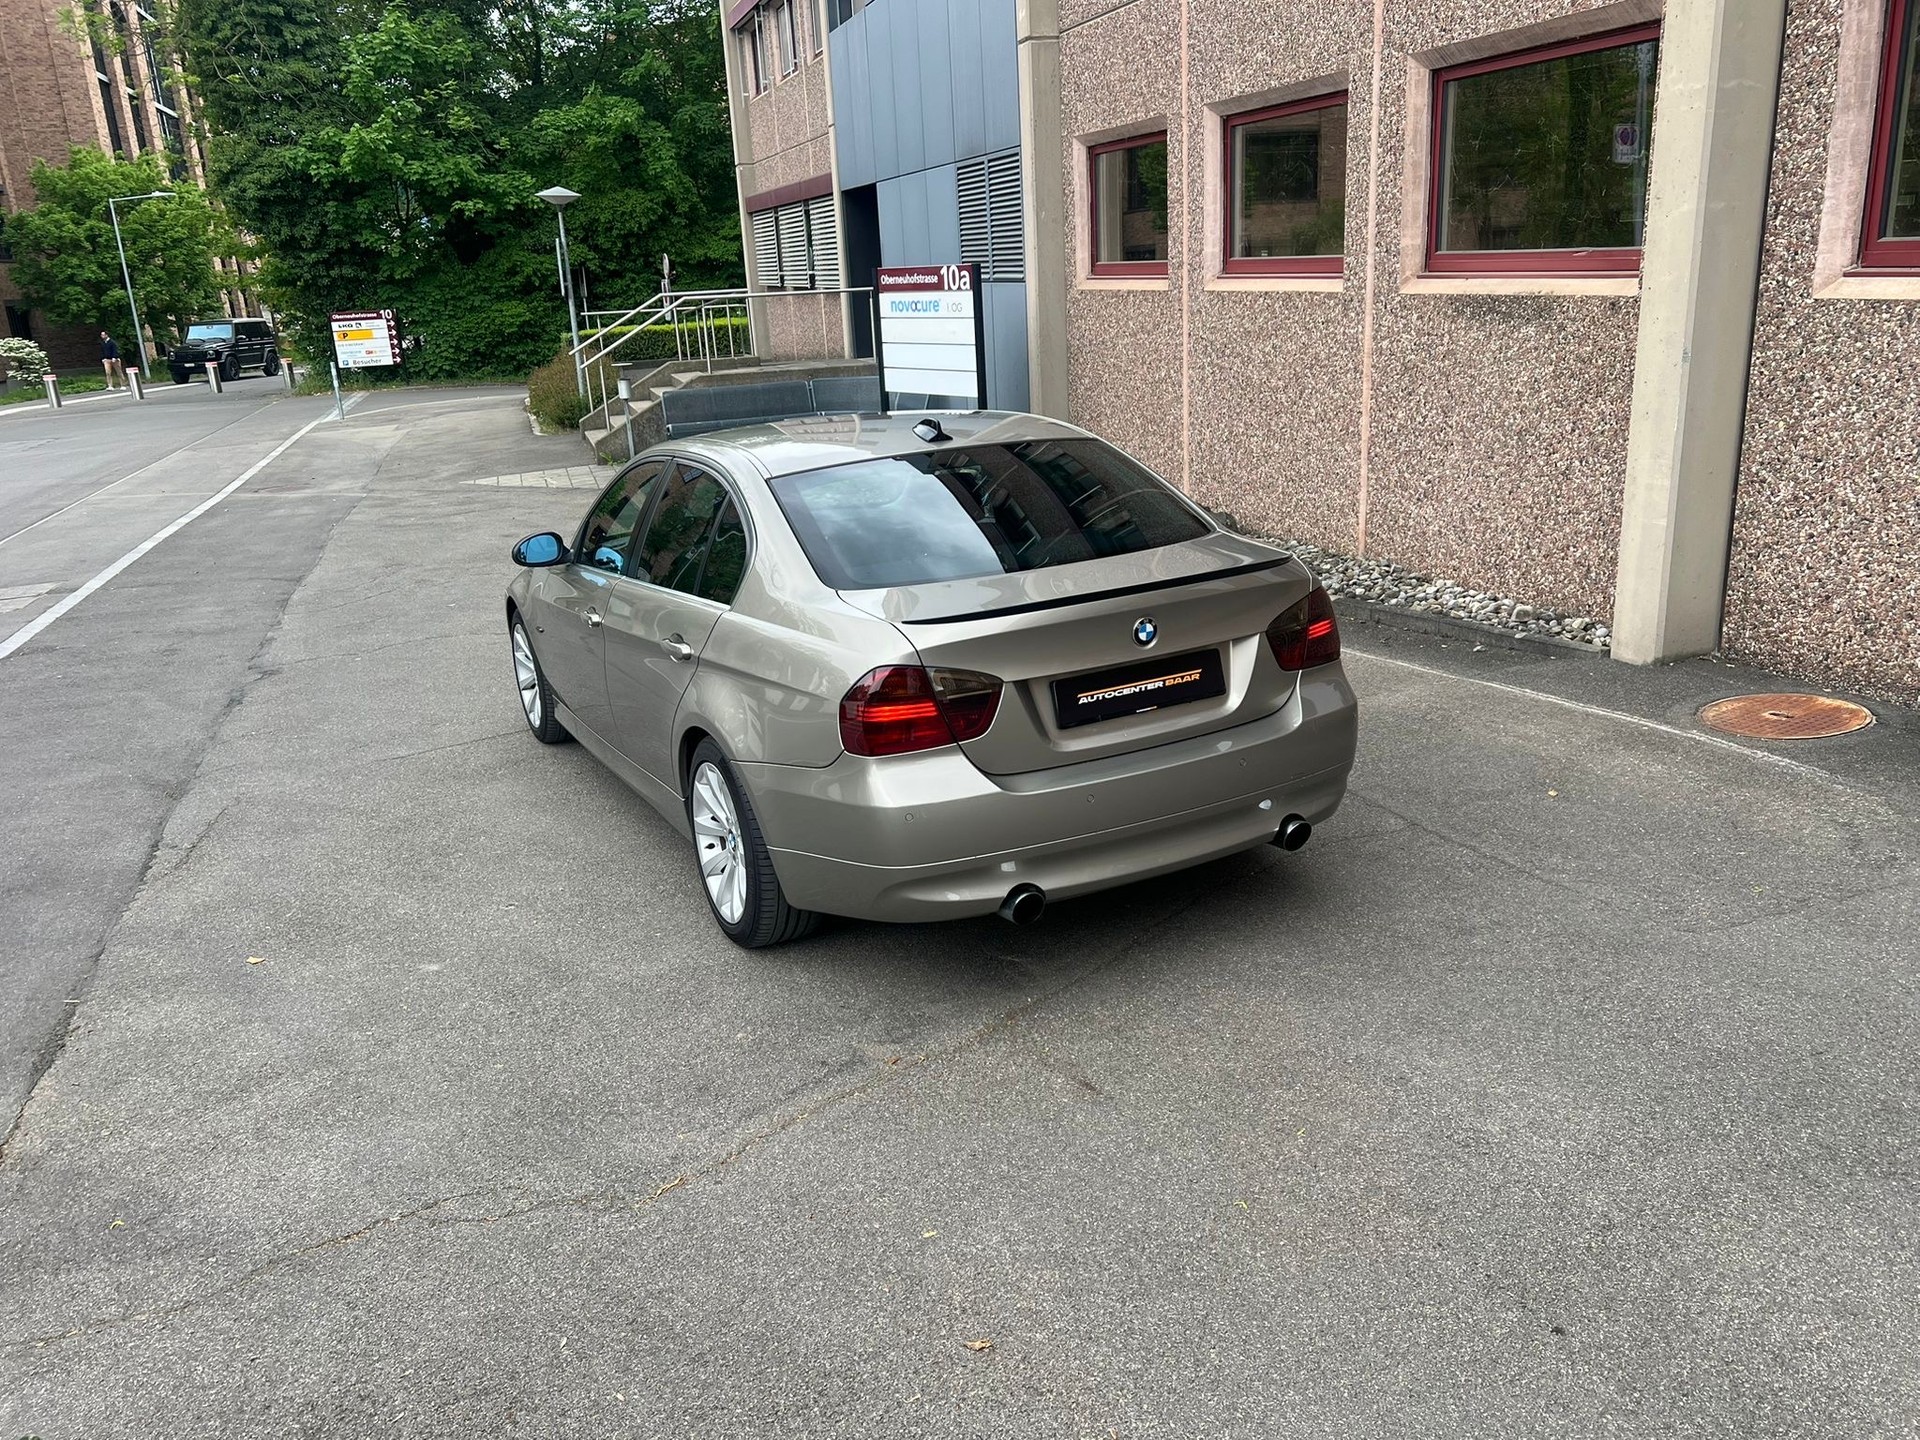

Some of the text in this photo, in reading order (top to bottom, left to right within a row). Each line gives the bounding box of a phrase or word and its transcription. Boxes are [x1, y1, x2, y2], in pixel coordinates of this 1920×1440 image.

[880, 265, 971, 290] Oberneuhofstrasse 10a
[332, 309, 392, 320] Oberneuhofstrasse 10
[890, 299, 940, 313] novocure
[1078, 673, 1200, 705] AUTOCENTER BAAR
